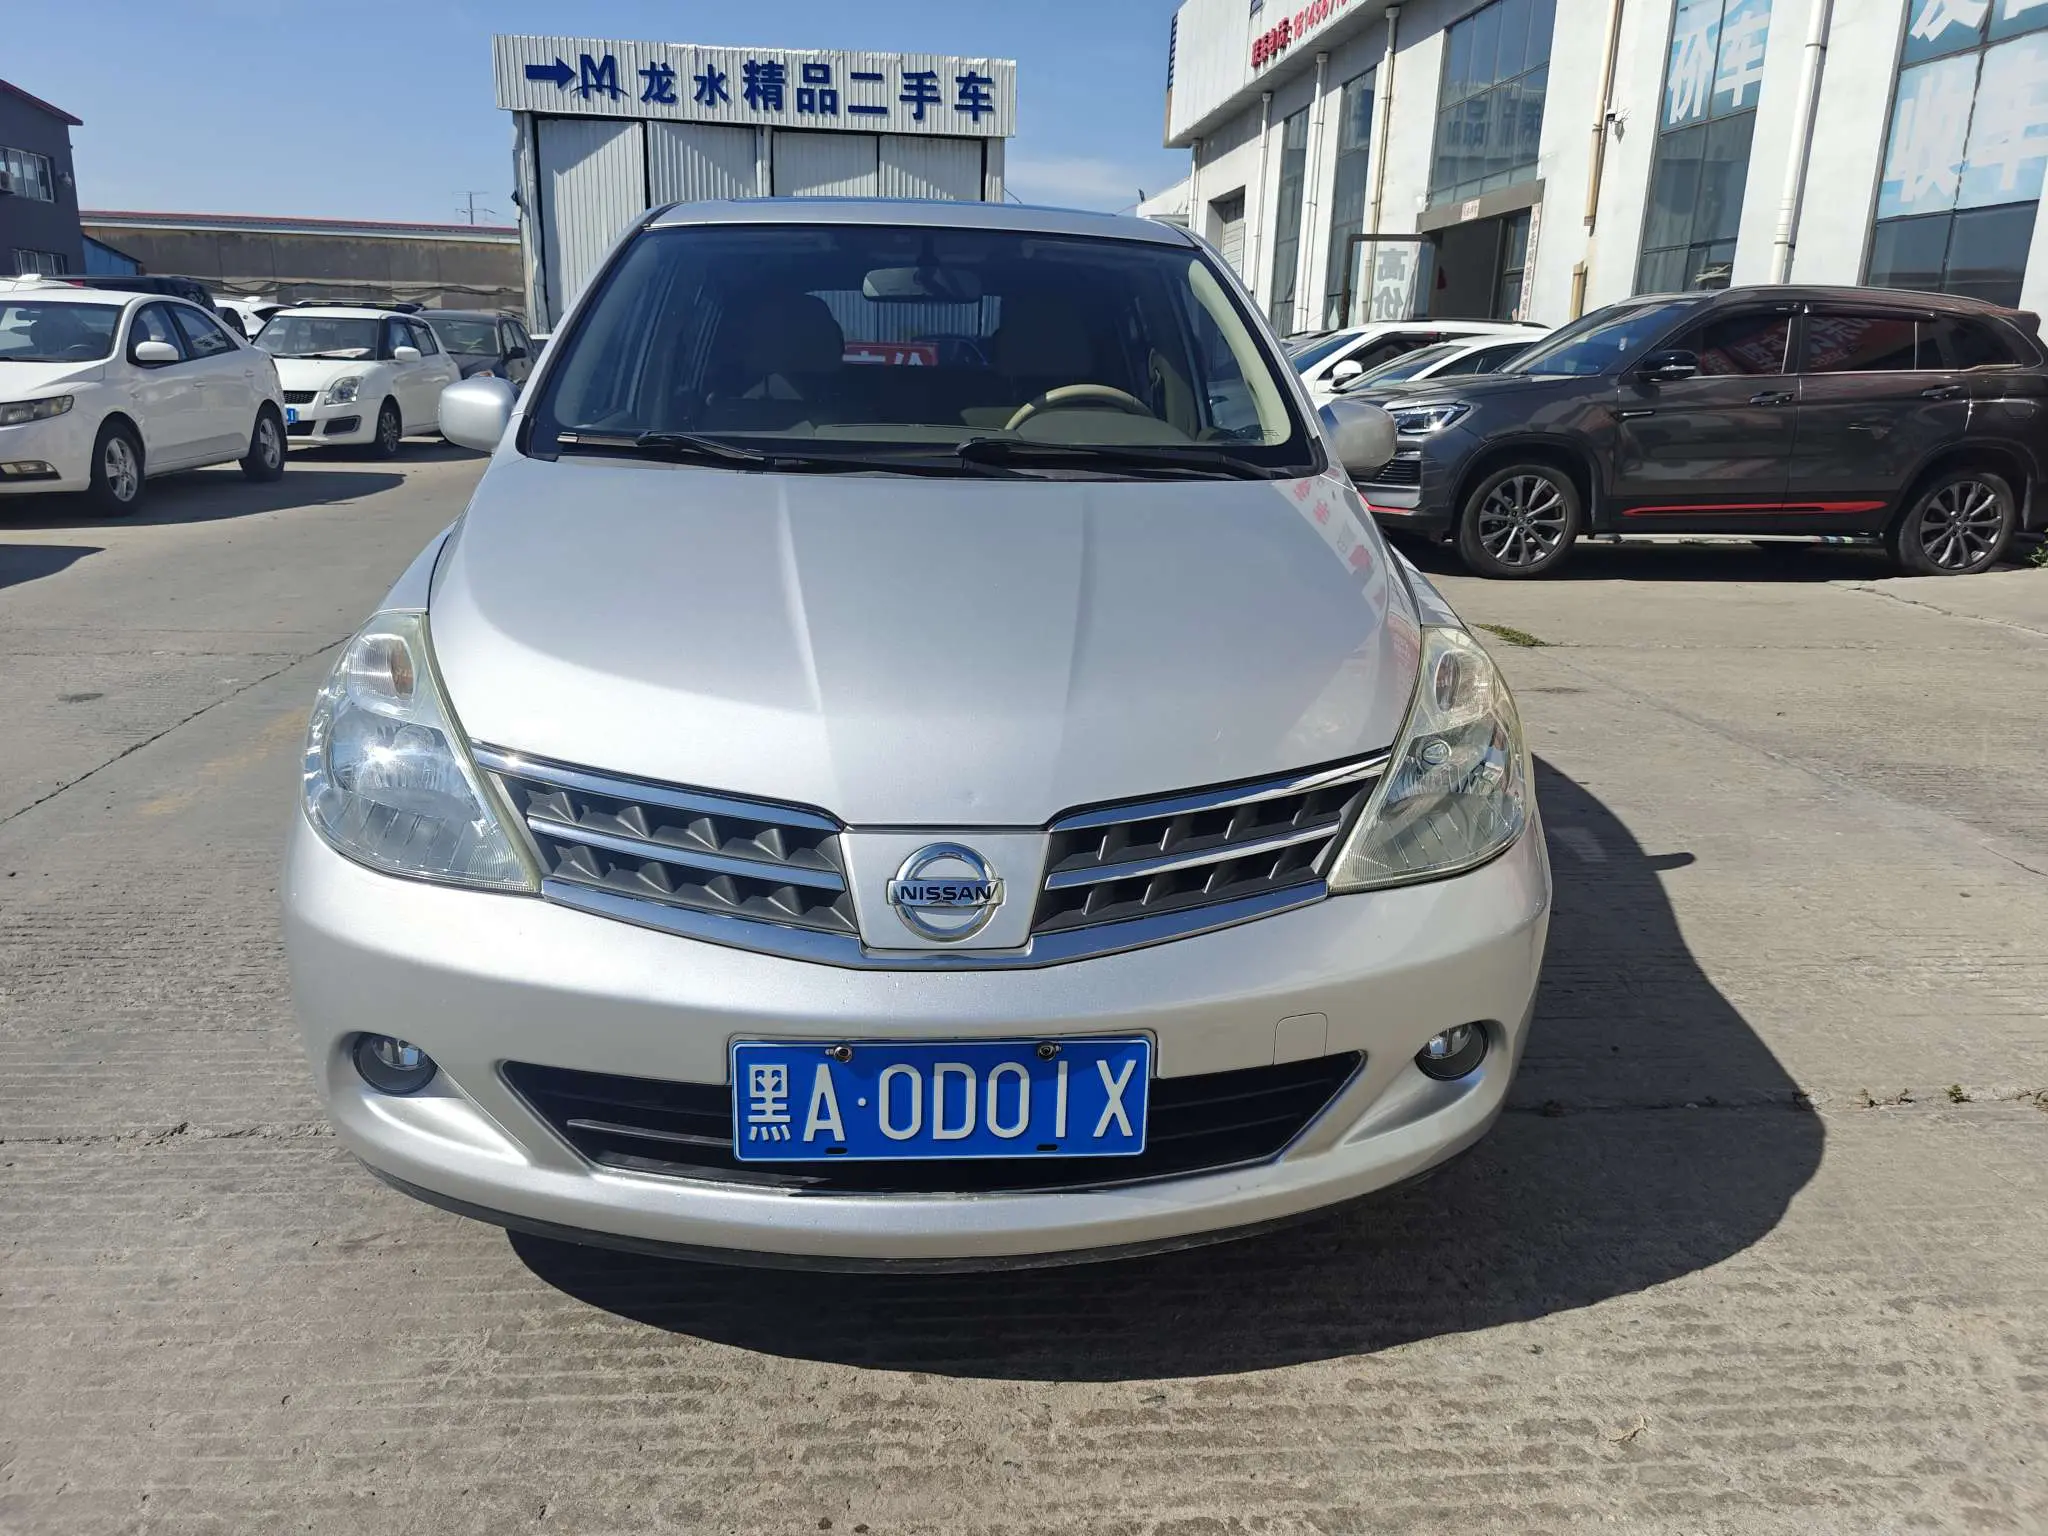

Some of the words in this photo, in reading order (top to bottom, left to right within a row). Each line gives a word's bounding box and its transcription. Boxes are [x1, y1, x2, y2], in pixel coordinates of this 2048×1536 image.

[637, 59, 994, 121] 龙水精品二手车
[900, 886, 992, 901] NISSAN
